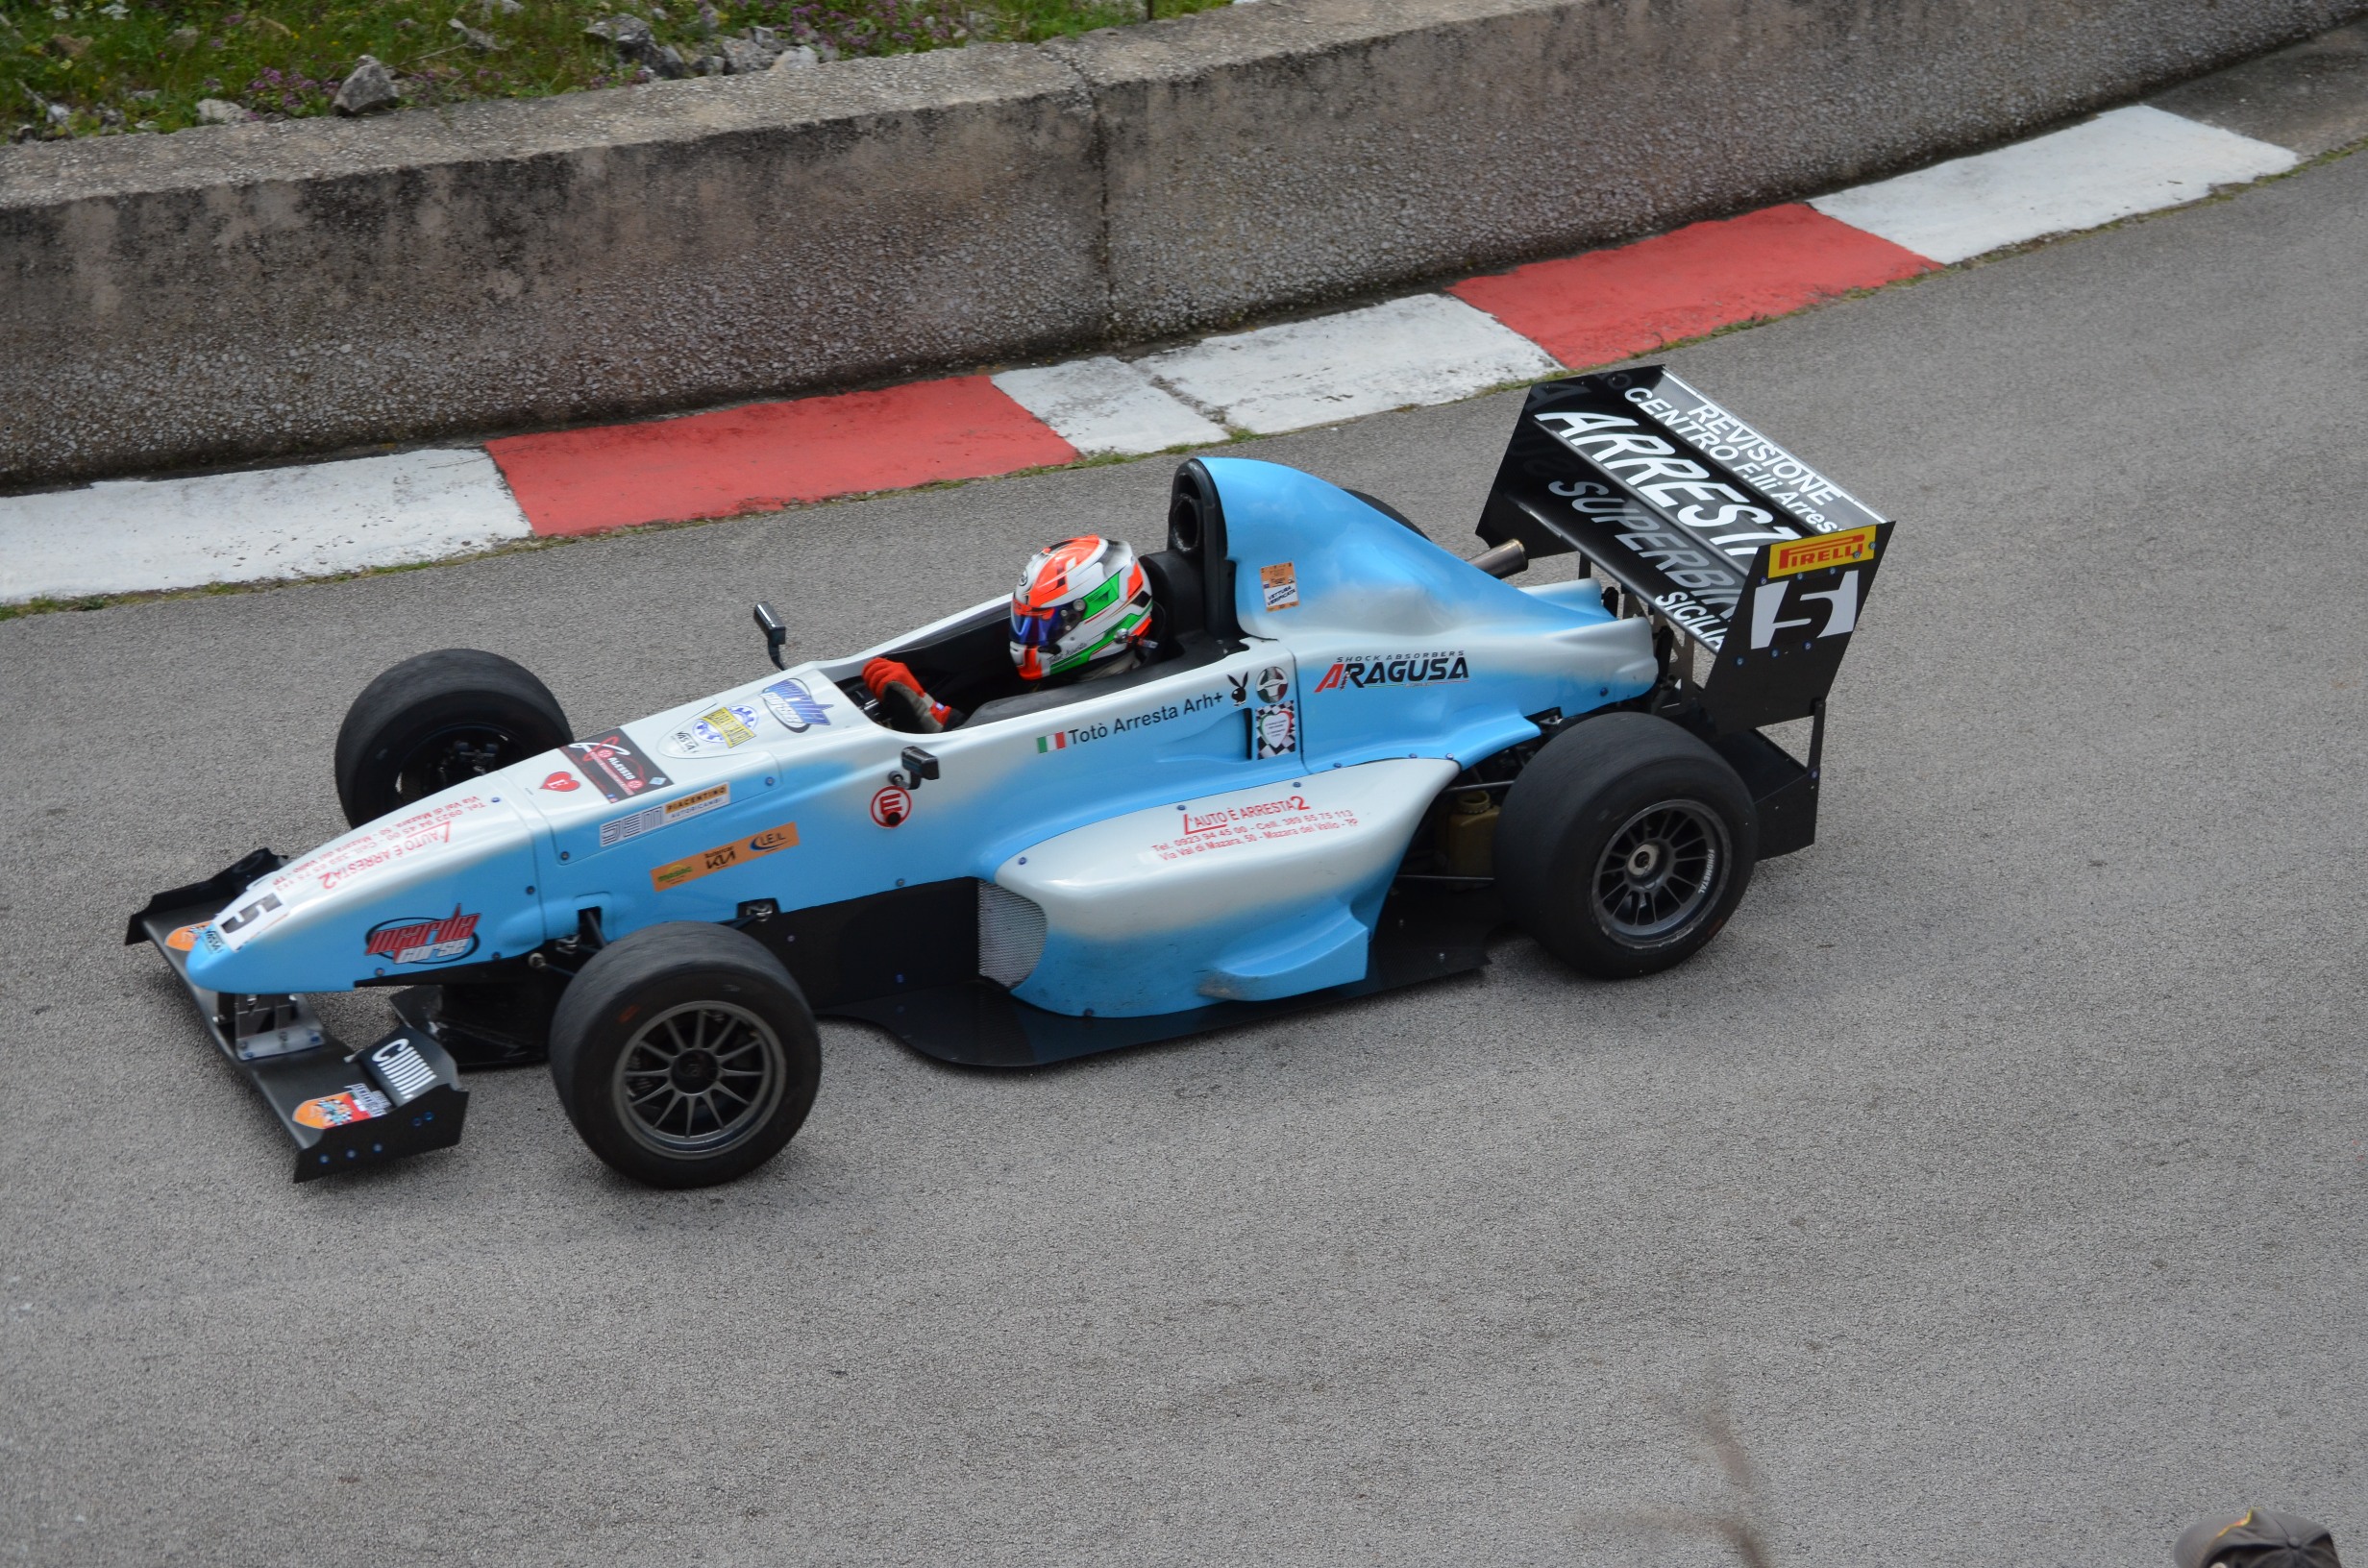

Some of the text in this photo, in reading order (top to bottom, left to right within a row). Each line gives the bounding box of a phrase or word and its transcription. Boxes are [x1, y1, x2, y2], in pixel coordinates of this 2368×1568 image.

[1624, 387, 1739, 461] CENTRO
[1775, 492, 1845, 534] Arres
[1688, 401, 1842, 505] REVISIONE
[1534, 411, 1802, 556] ARREST
[1779, 534, 1865, 569] PIRELLI
[1768, 573, 1846, 647] 5
[1337, 650, 1465, 663] SHOCK ABSORBERS
[1068, 692, 1222, 745] Totò Arresta Arh+
[607, 757, 636, 780] ALESSIO
[667, 786, 726, 811] PIACENTINO
[671, 797, 723, 818] AUTORICAMBI
[1159, 851, 1178, 861] Via
[1176, 846, 1194, 856] Val
[1263, 828, 1299, 839] Mazara
[1315, 821, 1341, 830] Vallo
[1174, 835, 1201, 846] 0923
[1698, 848, 1715, 894] FONDMETAL
[221, 892, 283, 934] 5
